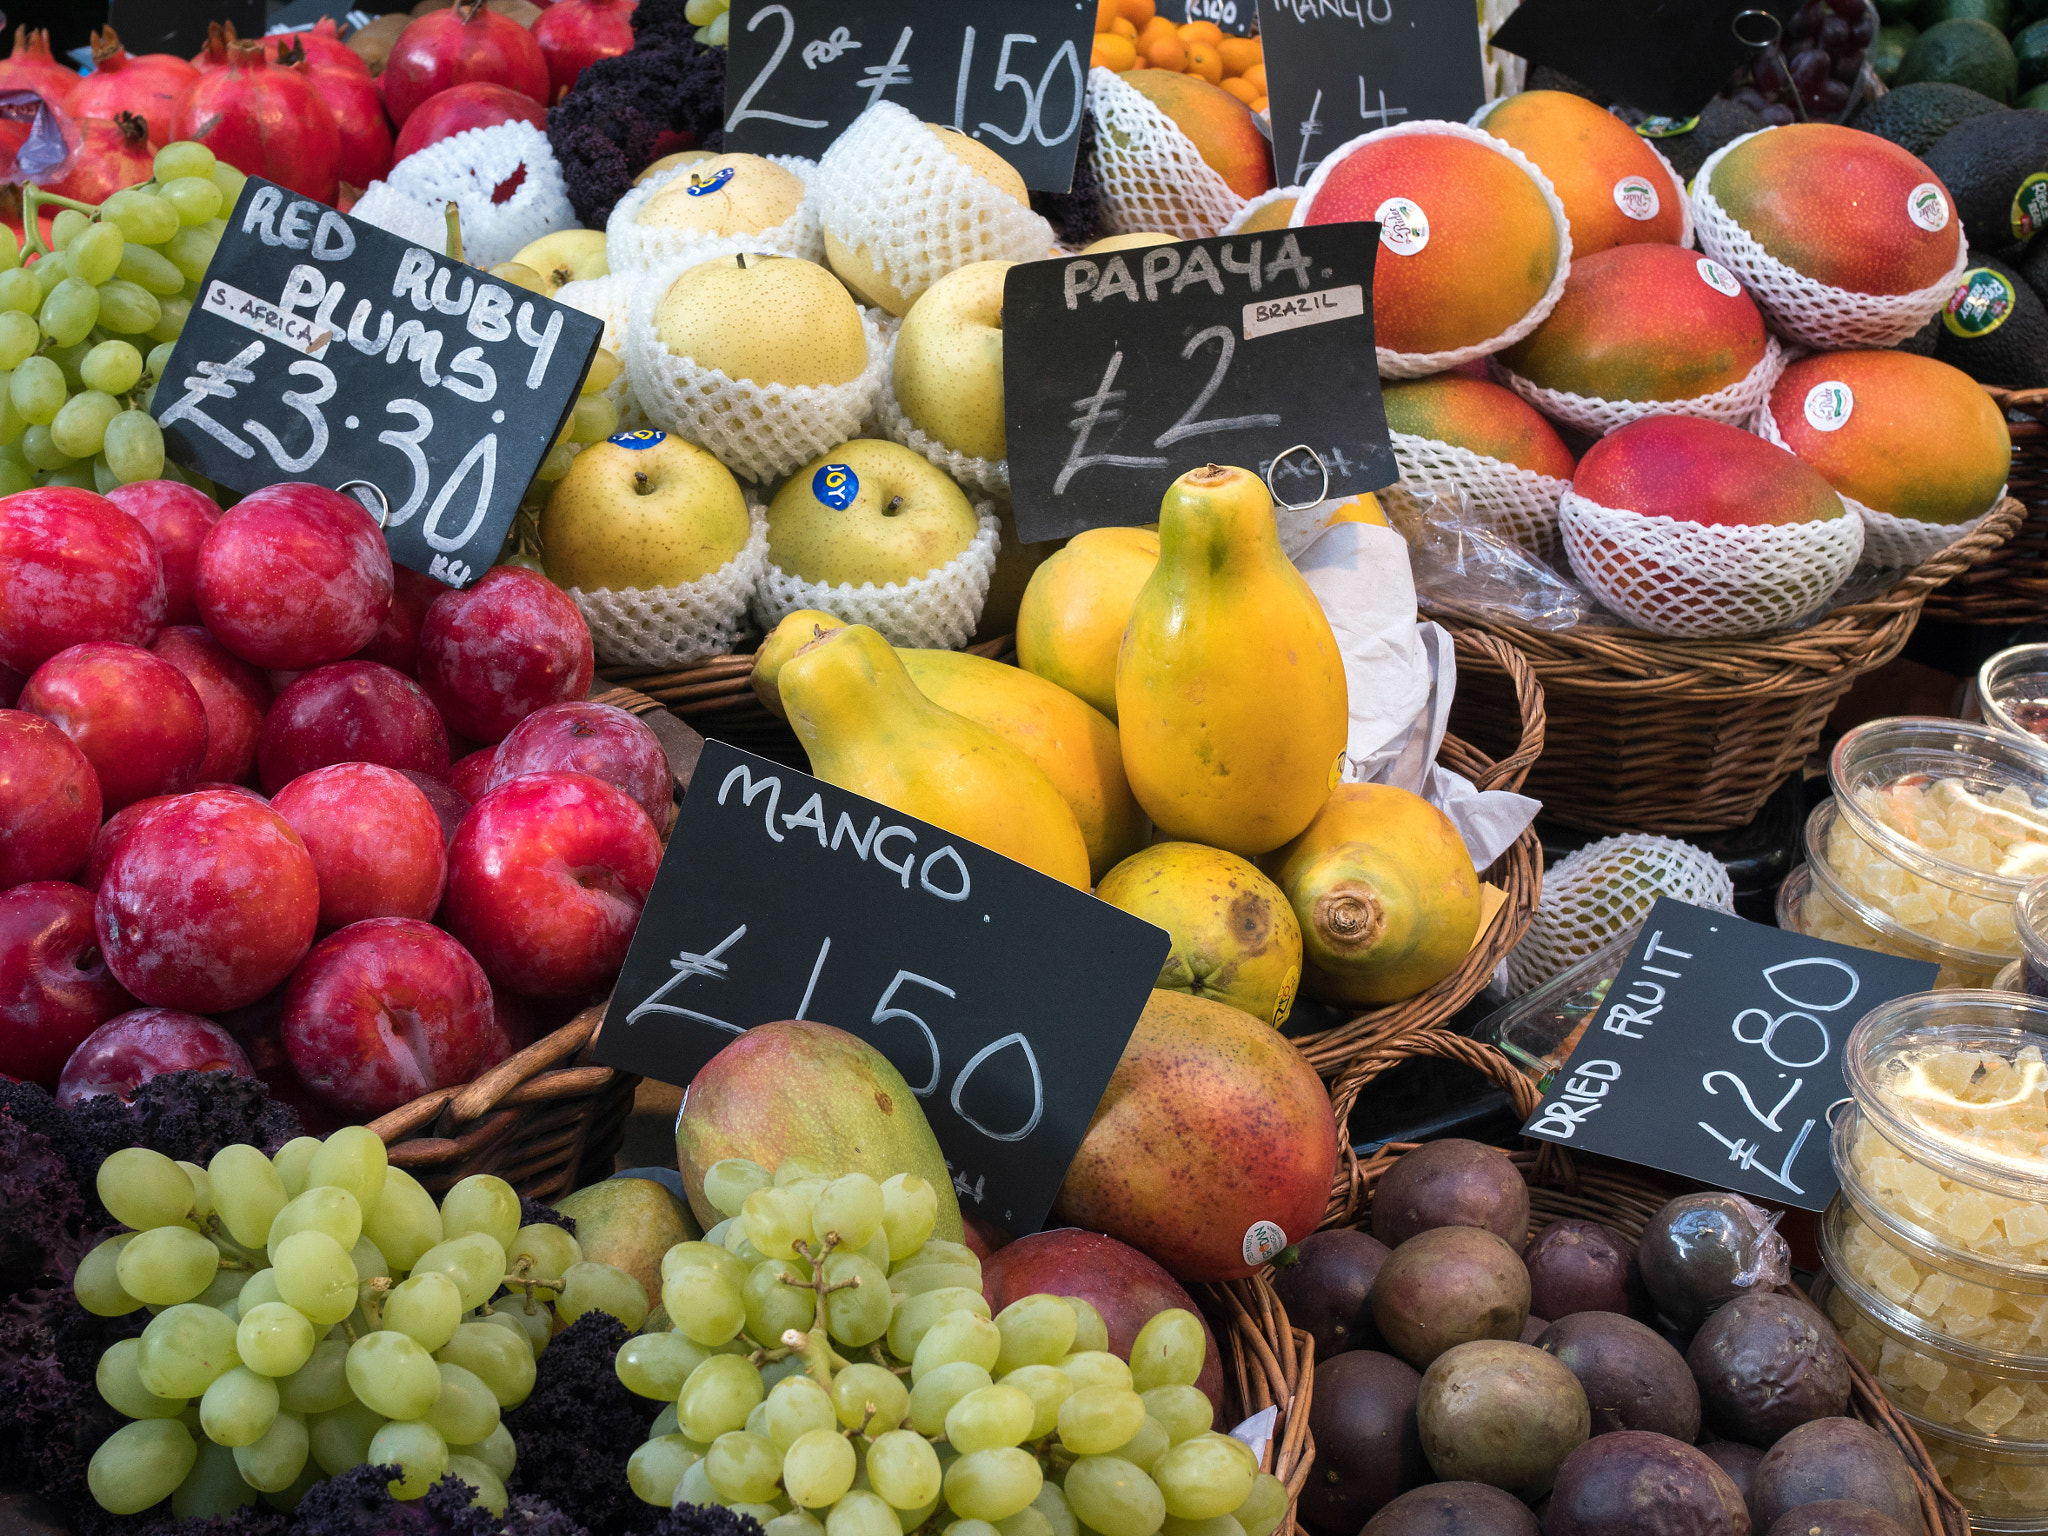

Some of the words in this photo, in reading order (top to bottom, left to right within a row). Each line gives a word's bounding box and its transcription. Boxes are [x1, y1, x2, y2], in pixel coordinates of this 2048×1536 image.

[725, 4, 829, 133] 2
[802, 26, 863, 70] FOR
[211, 288, 234, 311] S.
[239, 299, 313, 346] AFRICA
[242, 186, 356, 261] RED
[393, 248, 564, 389] RUBY
[1256, 294, 1338, 322] BRAZIL
[157, 340, 498, 553] £3.30
[1053, 324, 1282, 495] £2
[1529, 1058, 1623, 1139] DRIED
[1697, 956, 1861, 1195] £2.80
